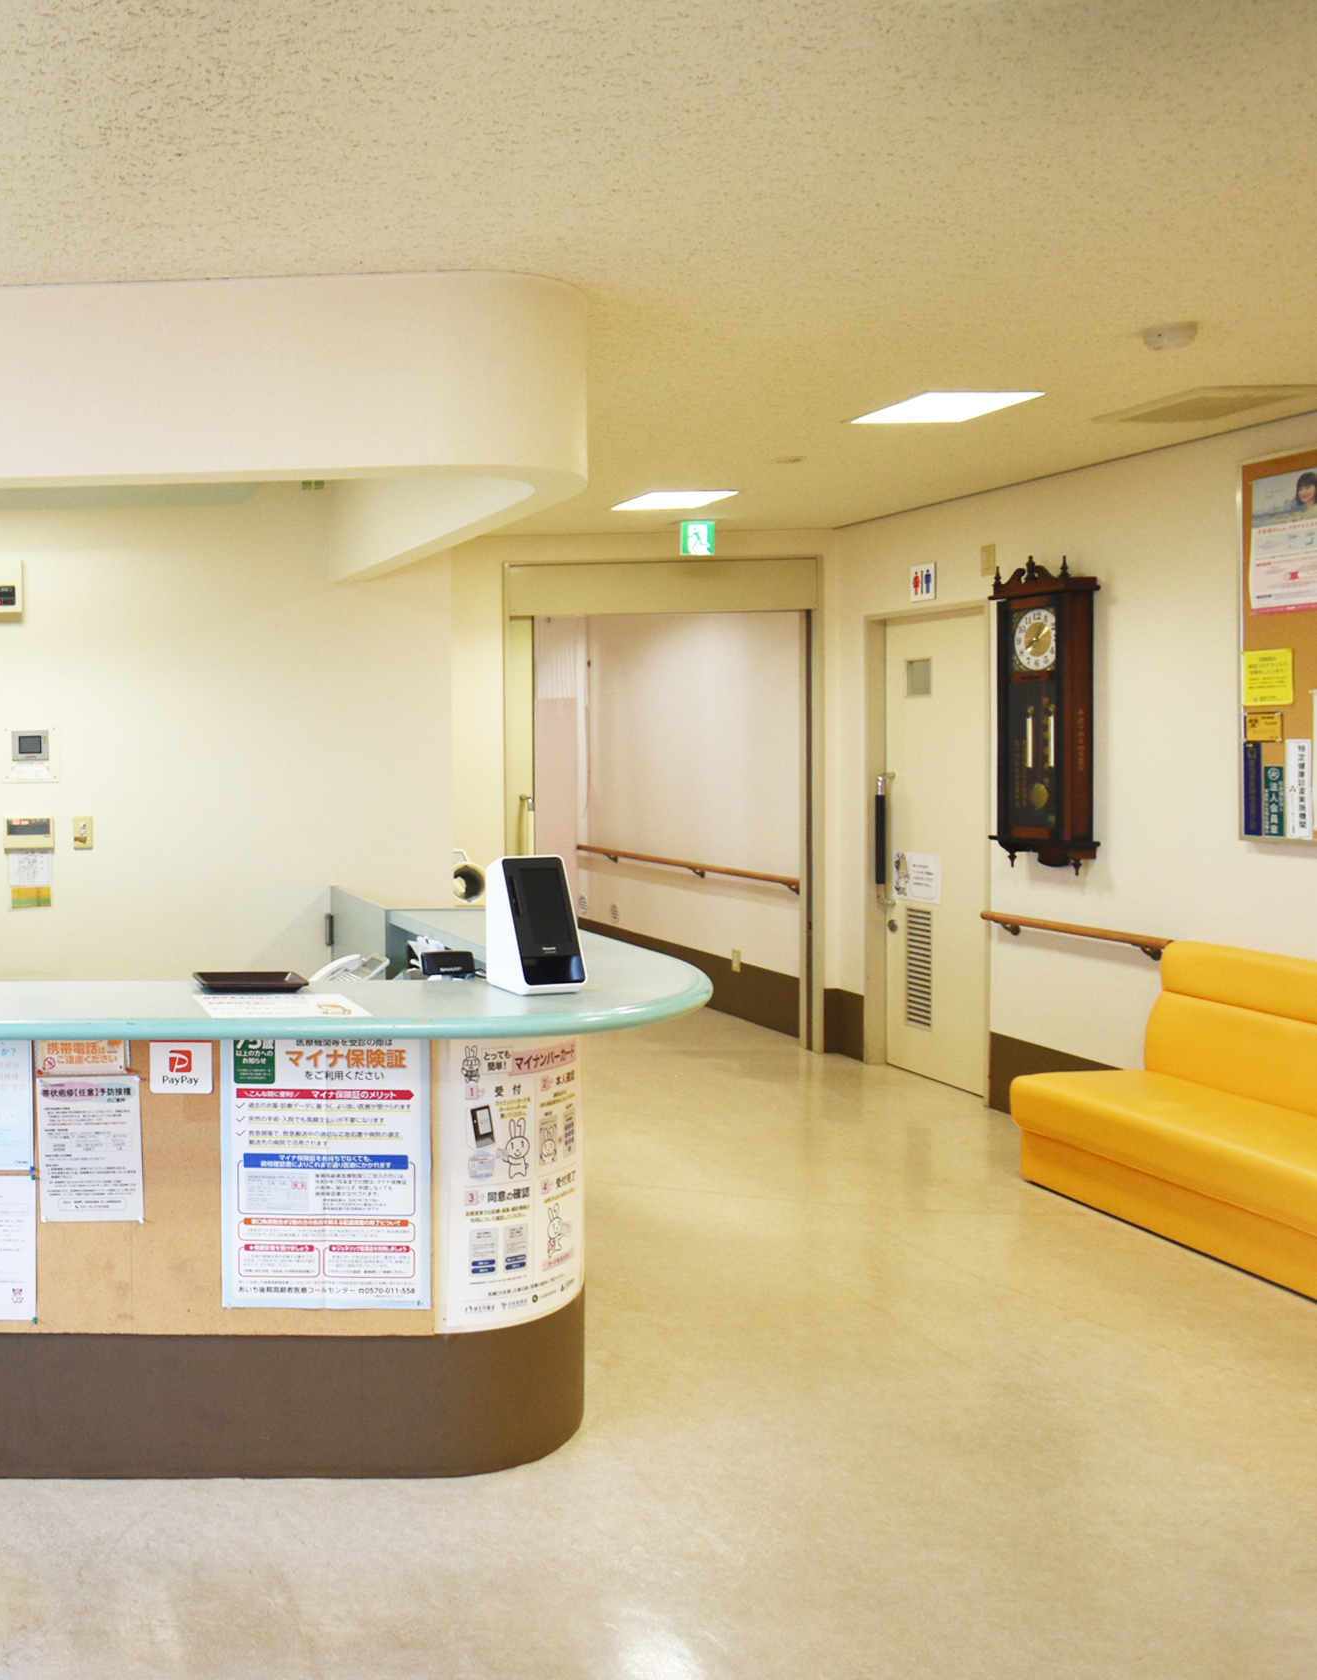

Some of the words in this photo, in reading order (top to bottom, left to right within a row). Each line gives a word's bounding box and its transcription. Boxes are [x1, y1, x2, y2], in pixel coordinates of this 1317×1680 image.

[57, 1055, 118, 1064] ご遠慮ください
[285, 1049, 407, 1069] マイナ保険証
[483, 1050, 511, 1060] とっても
[514, 1044, 575, 1070] マイナンバーカード
[162, 1075, 199, 1086] PayPay
[304, 1070, 385, 1081] をご利用ください
[468, 1193, 475, 1203] 3
[487, 1186, 531, 1203] 同意の確認
